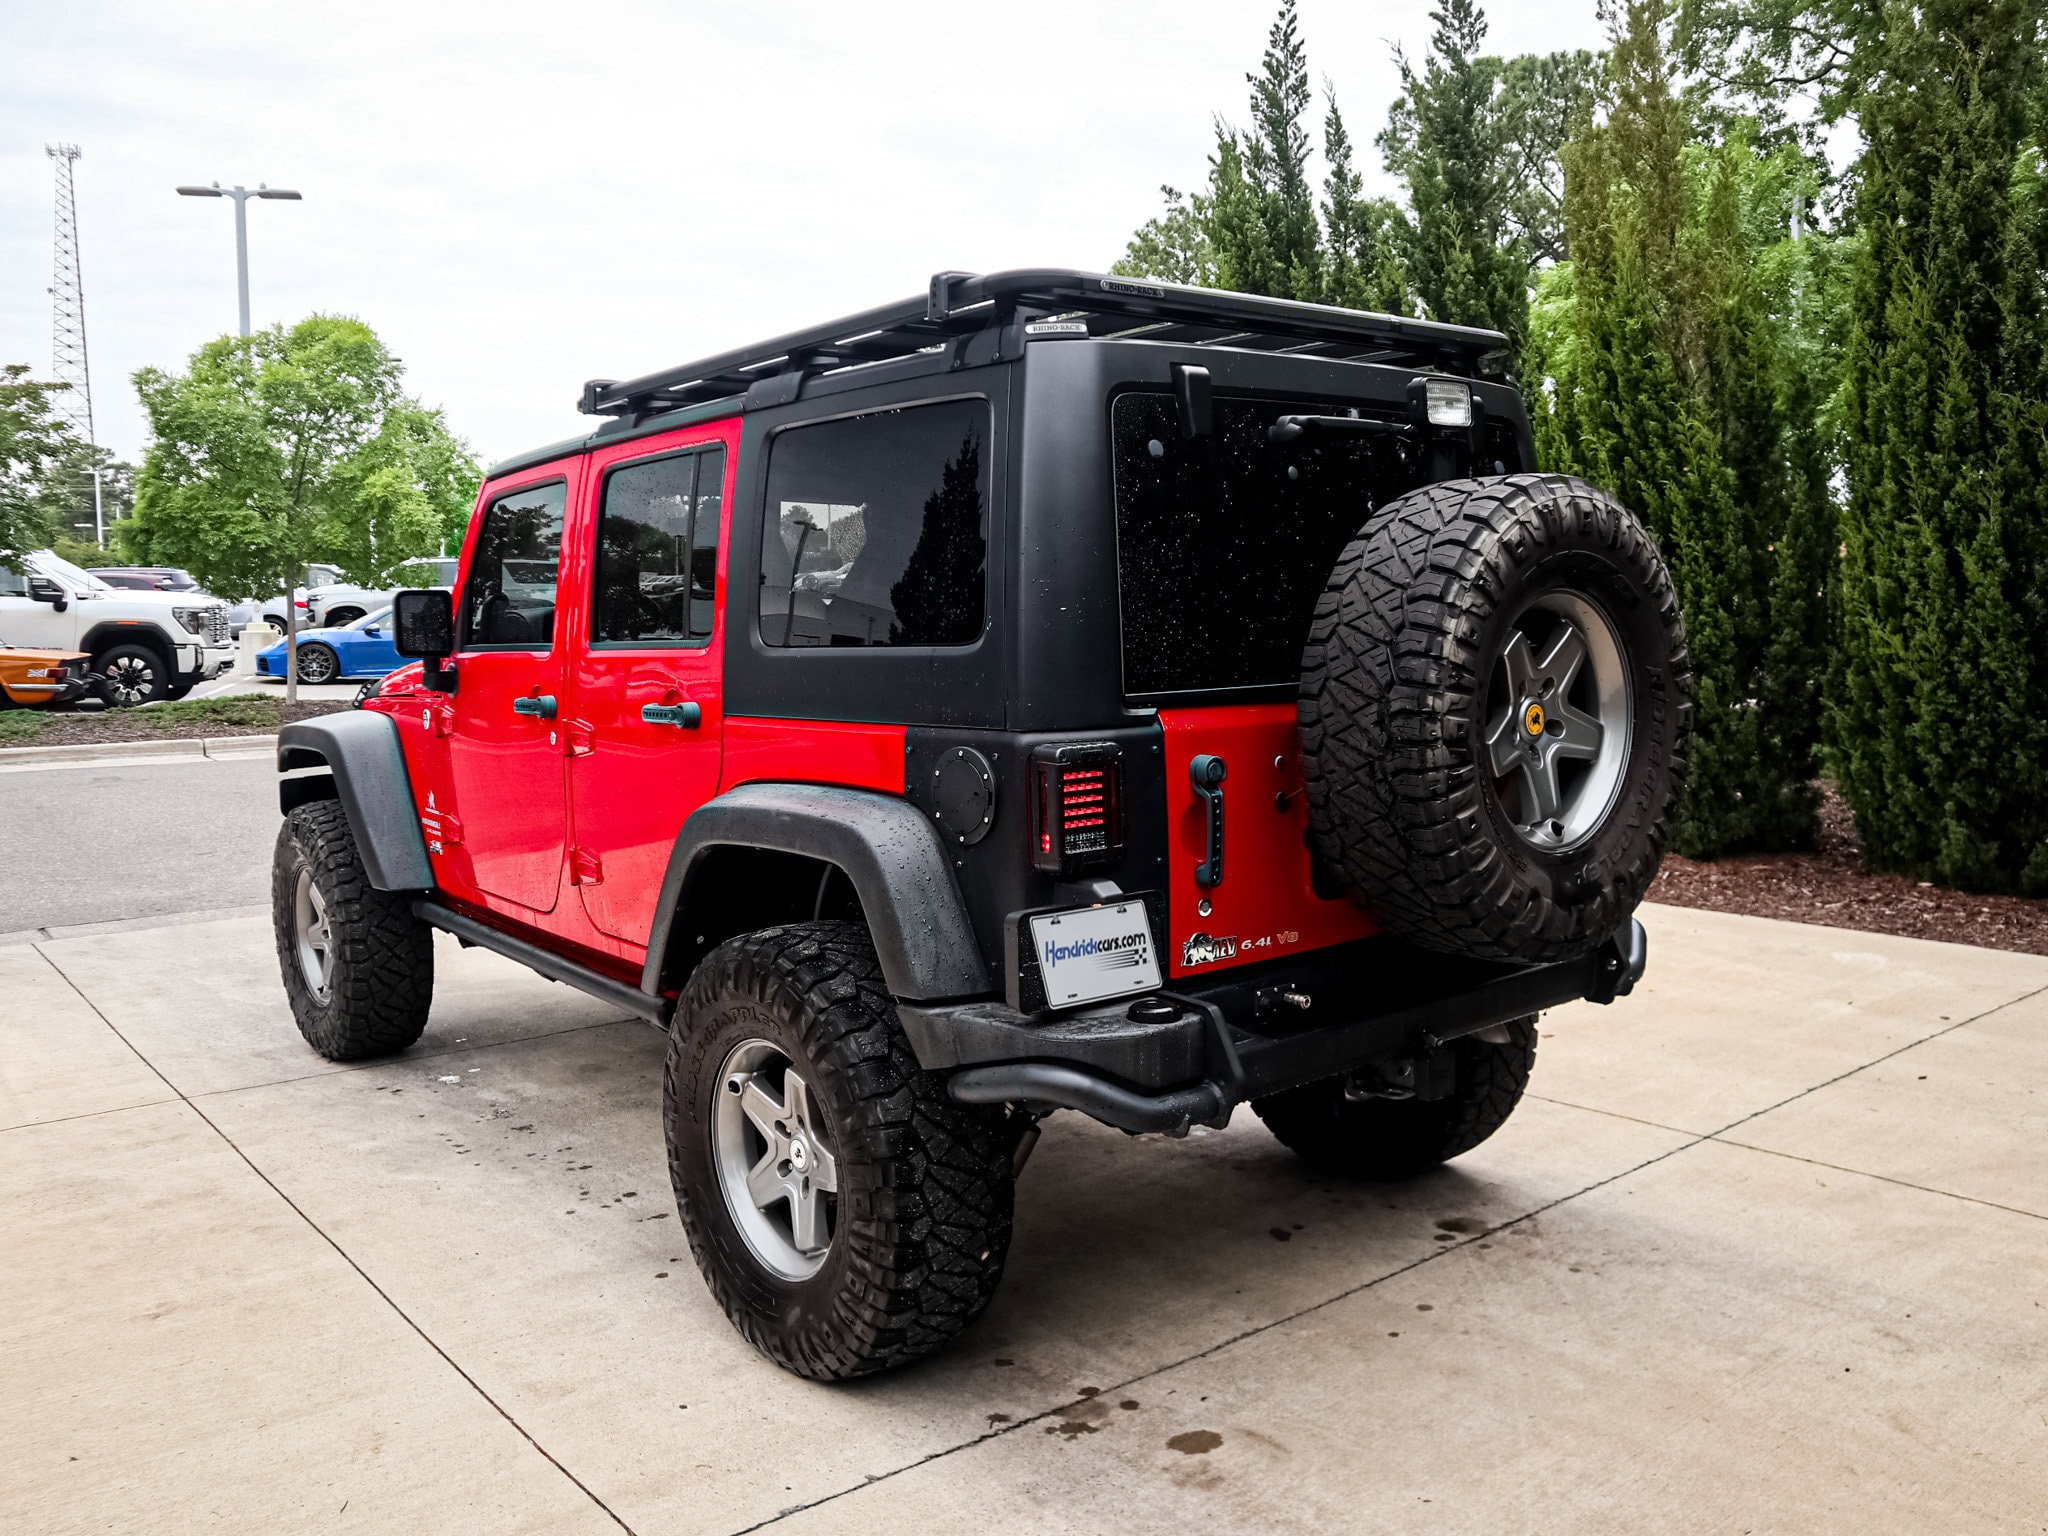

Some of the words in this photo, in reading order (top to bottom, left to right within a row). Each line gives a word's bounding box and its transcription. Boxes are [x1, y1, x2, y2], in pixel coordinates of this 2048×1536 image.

[1108, 281, 1159, 297] RHINO-RACK
[1032, 323, 1082, 332] RHINO-RACK
[1045, 932, 1146, 968] Hendrickcars.com
